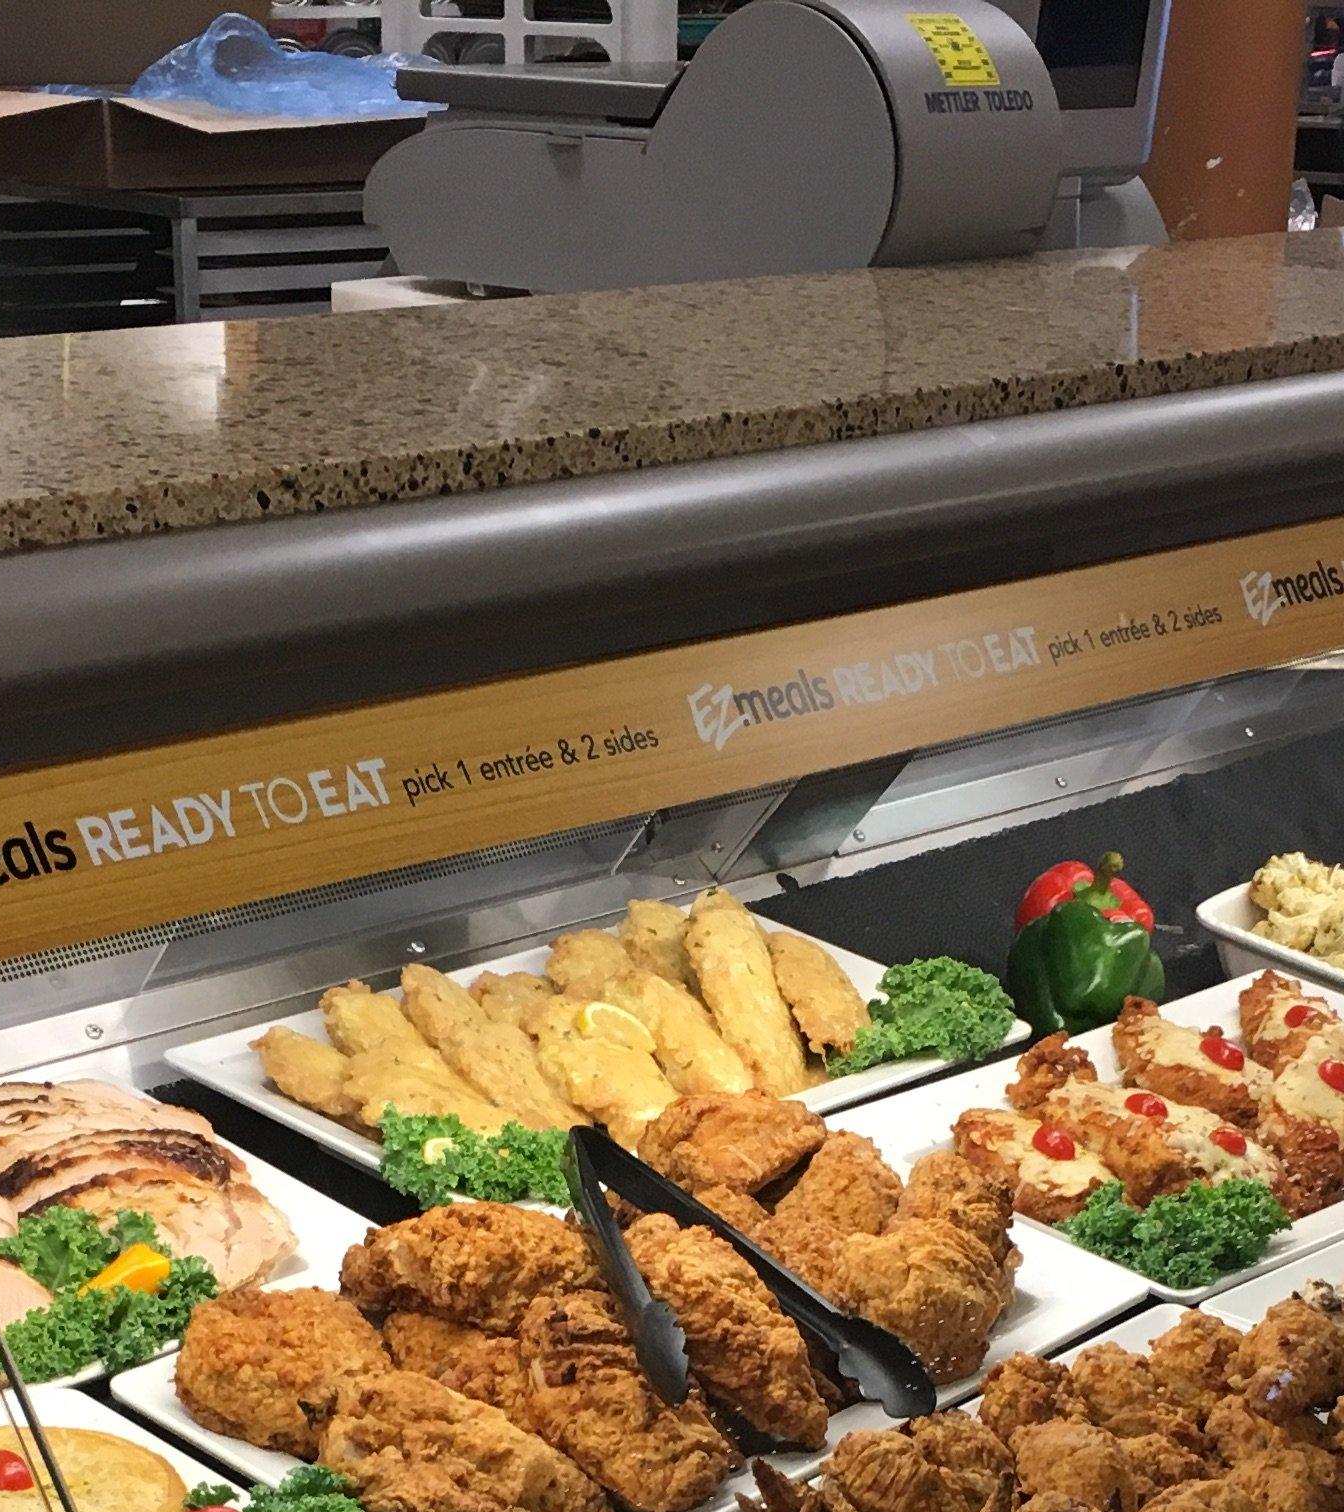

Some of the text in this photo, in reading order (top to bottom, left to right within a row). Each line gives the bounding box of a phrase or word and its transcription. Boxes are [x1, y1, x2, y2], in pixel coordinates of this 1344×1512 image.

[924, 90, 1034, 114] METTLER TOLEDO
[832, 650, 939, 706] READY
[938, 639, 982, 682] TO
[982, 626, 1040, 676] EAT
[1048, 632, 1081, 667] pick
[1083, 629, 1095, 650] 1
[1100, 618, 1148, 647] entrée
[1152, 614, 1167, 636] &
[1170, 610, 1182, 632] 2
[1185, 604, 1222, 630] sides
[76, 789, 235, 866] READY
[238, 777, 307, 829] TO
[310, 758, 390, 817] EAT
[402, 765, 451, 805] pick
[457, 760, 471, 785] 1
[480, 745, 554, 781] entrée
[559, 739, 579, 765] &
[582, 734, 599, 760] 2
[603, 726, 659, 756] sides
